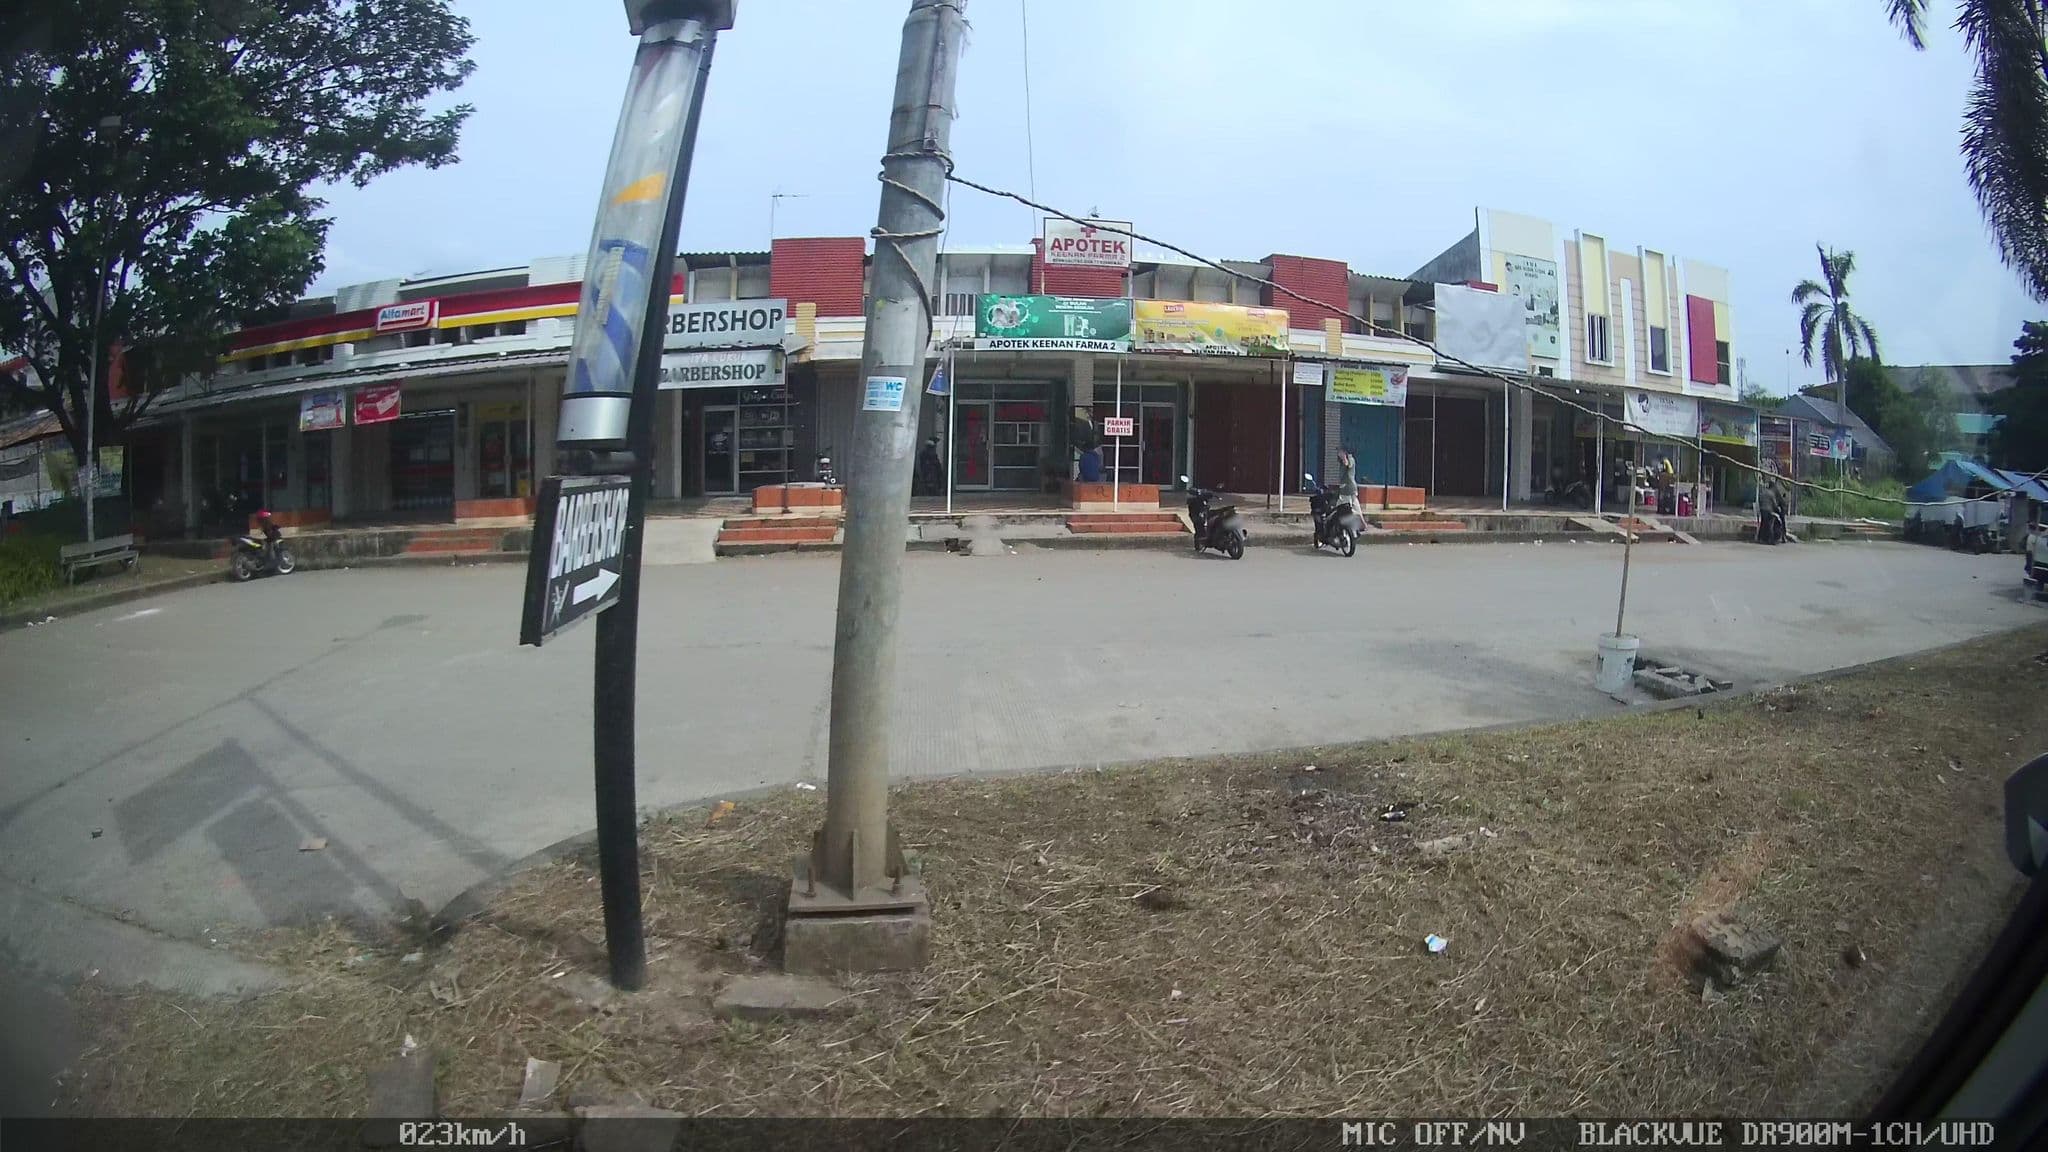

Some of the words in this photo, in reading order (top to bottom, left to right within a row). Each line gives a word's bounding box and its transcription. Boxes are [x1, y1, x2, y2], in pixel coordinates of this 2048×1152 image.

[1050, 238, 1126, 254] APOTEK
[381, 305, 425, 319] Alfamart
[989, 340, 1031, 348] APOTEK
[1032, 340, 1073, 348] KEENAN
[1076, 341, 1109, 350] FARMA
[1110, 342, 1116, 350] 2
[885, 382, 903, 391] WC
[550, 488, 629, 579] BARBERSHOP
